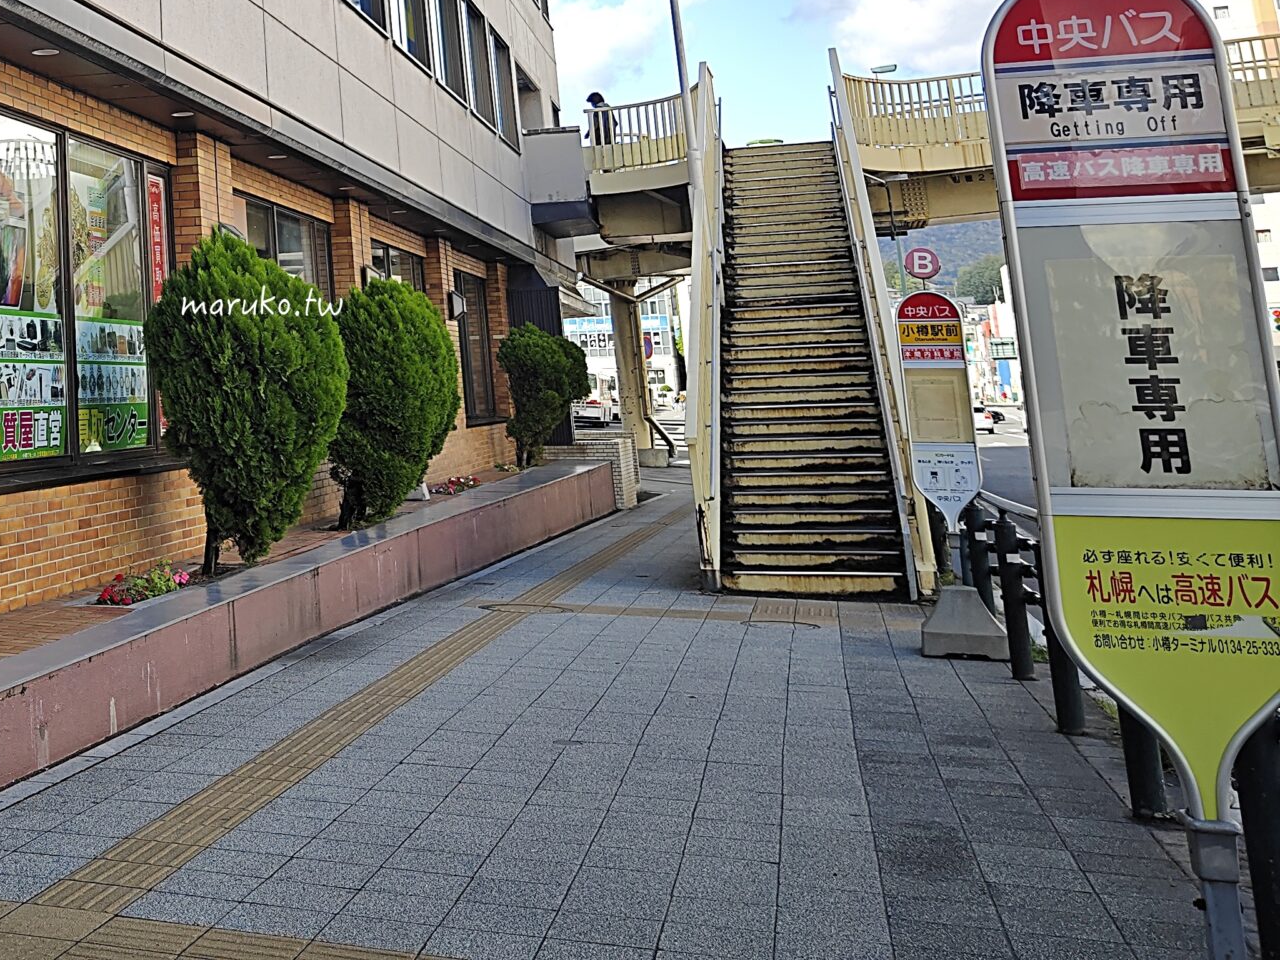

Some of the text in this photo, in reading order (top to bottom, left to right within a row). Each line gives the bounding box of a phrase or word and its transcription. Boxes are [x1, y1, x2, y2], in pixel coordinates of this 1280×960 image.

[1017, 9, 1180, 54] 中央バス
[1018, 73, 1204, 120] 降車専用
[1050, 115, 1178, 138] Getting Off
[1021, 154, 1223, 181] 高速バス降車専用
[912, 252, 933, 273] B
[904, 305, 951, 318] 中央バス
[902, 324, 959, 337] 小樽駅前
[1114, 273, 1192, 474] 降車専用
[2, 406, 147, 453] 質屋直営 買取センター
[1085, 569, 1280, 610] 札幌へは高速バス
